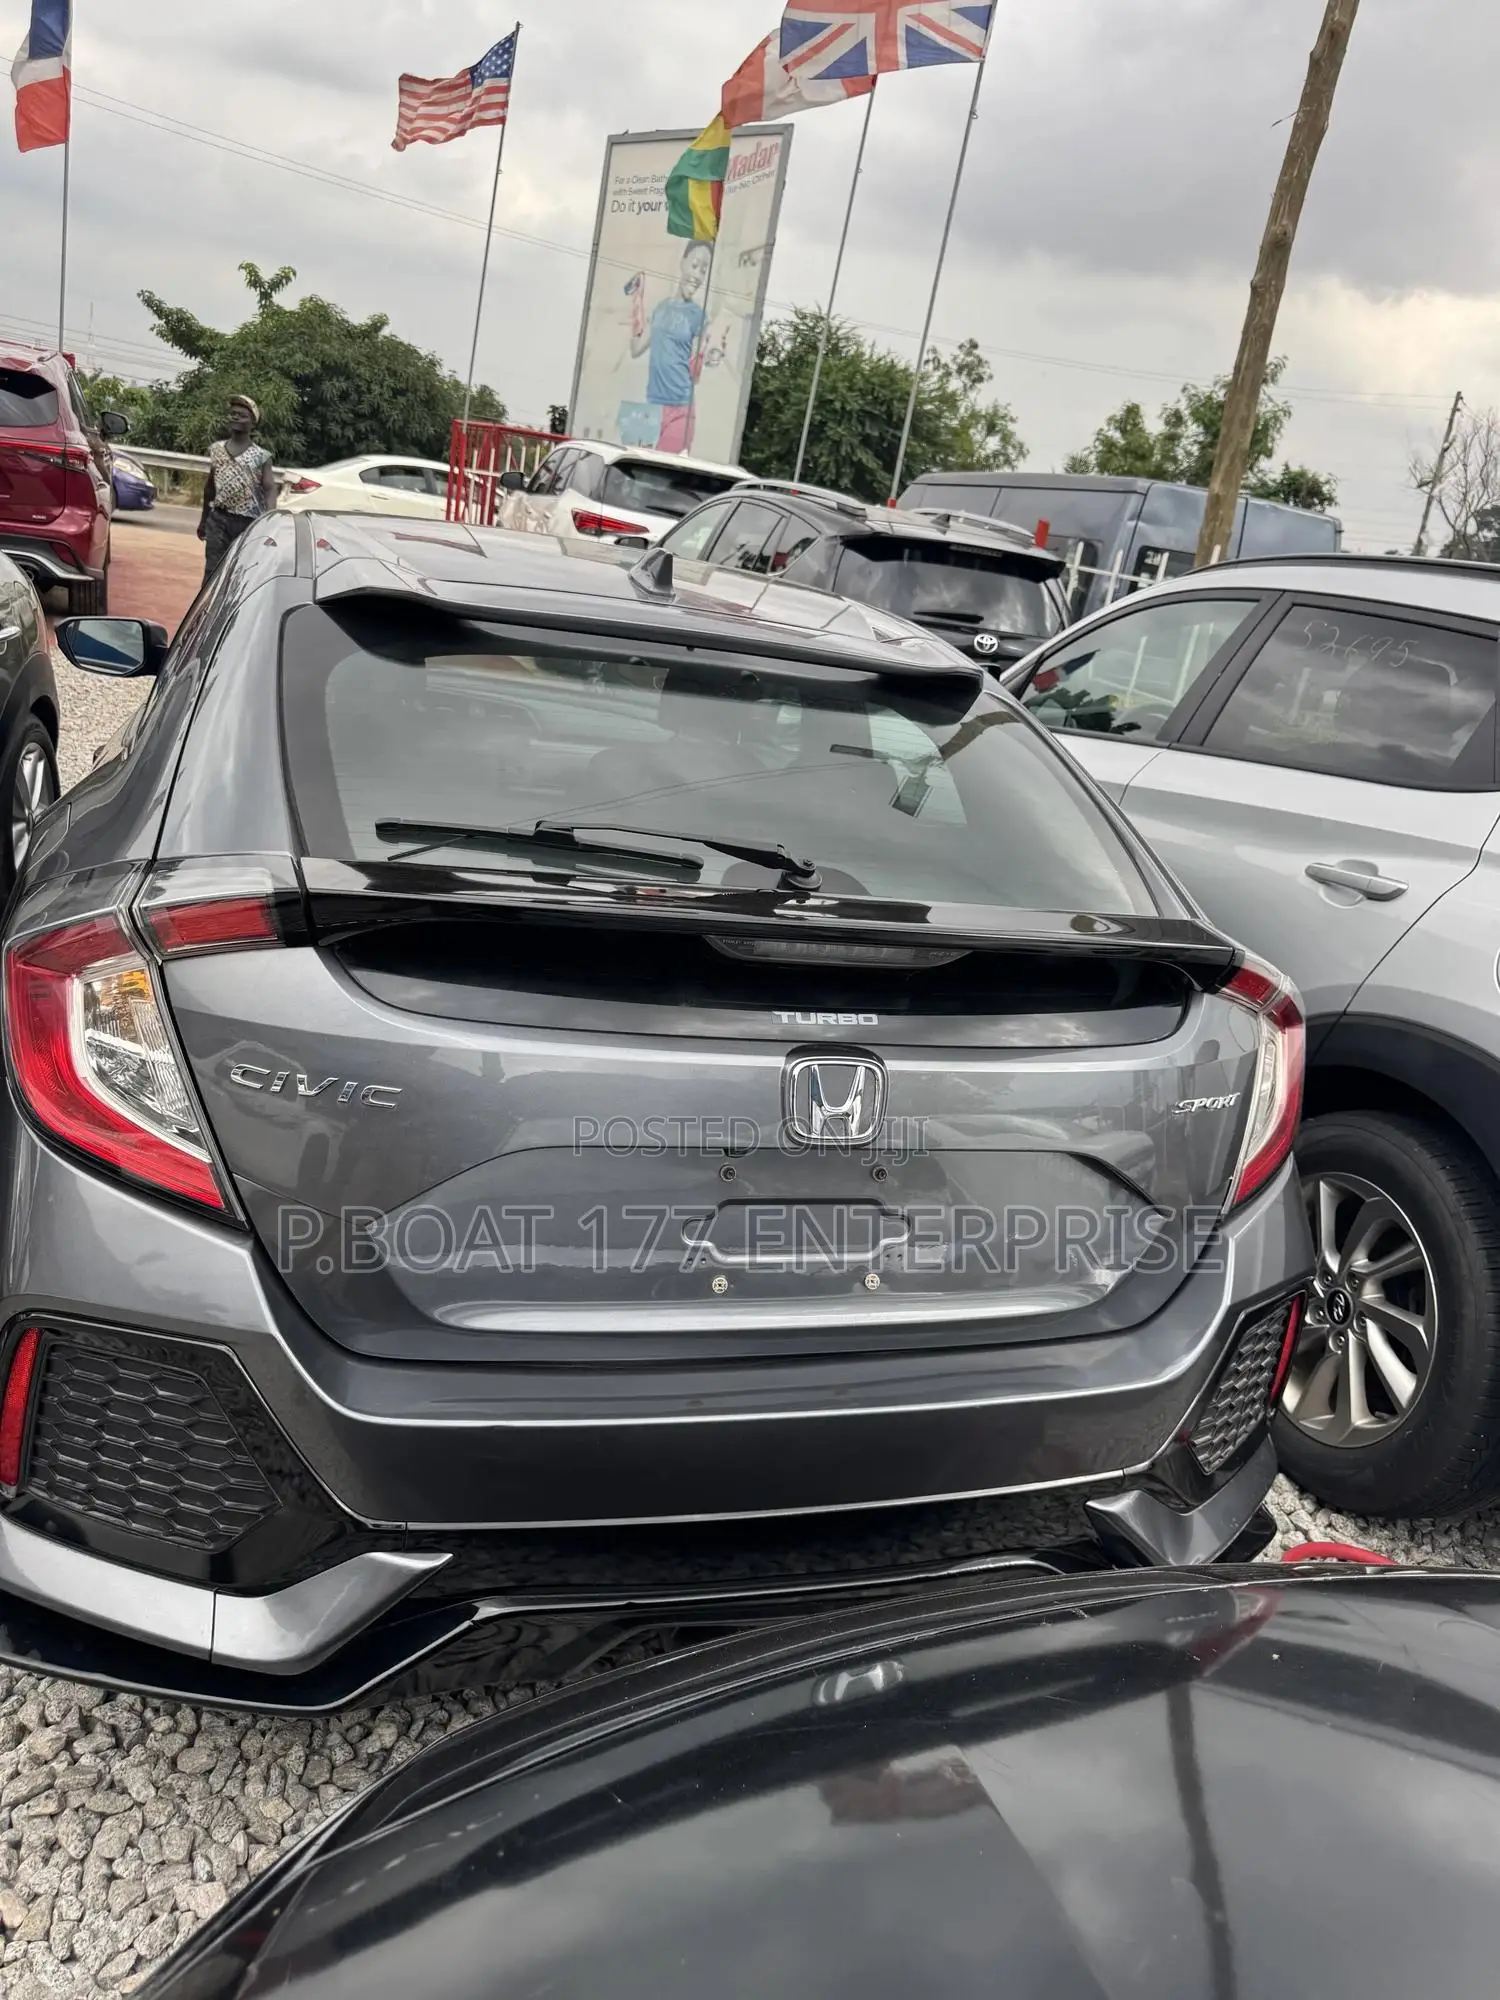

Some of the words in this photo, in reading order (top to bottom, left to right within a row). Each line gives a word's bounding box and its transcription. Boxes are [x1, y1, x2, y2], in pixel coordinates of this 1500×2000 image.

[611, 199, 627, 213] Do
[636, 200, 662, 216] your
[772, 1010, 879, 1026] TURBO
[230, 1063, 403, 1109] CIVIC
[1172, 1092, 1241, 1114] SPORT
